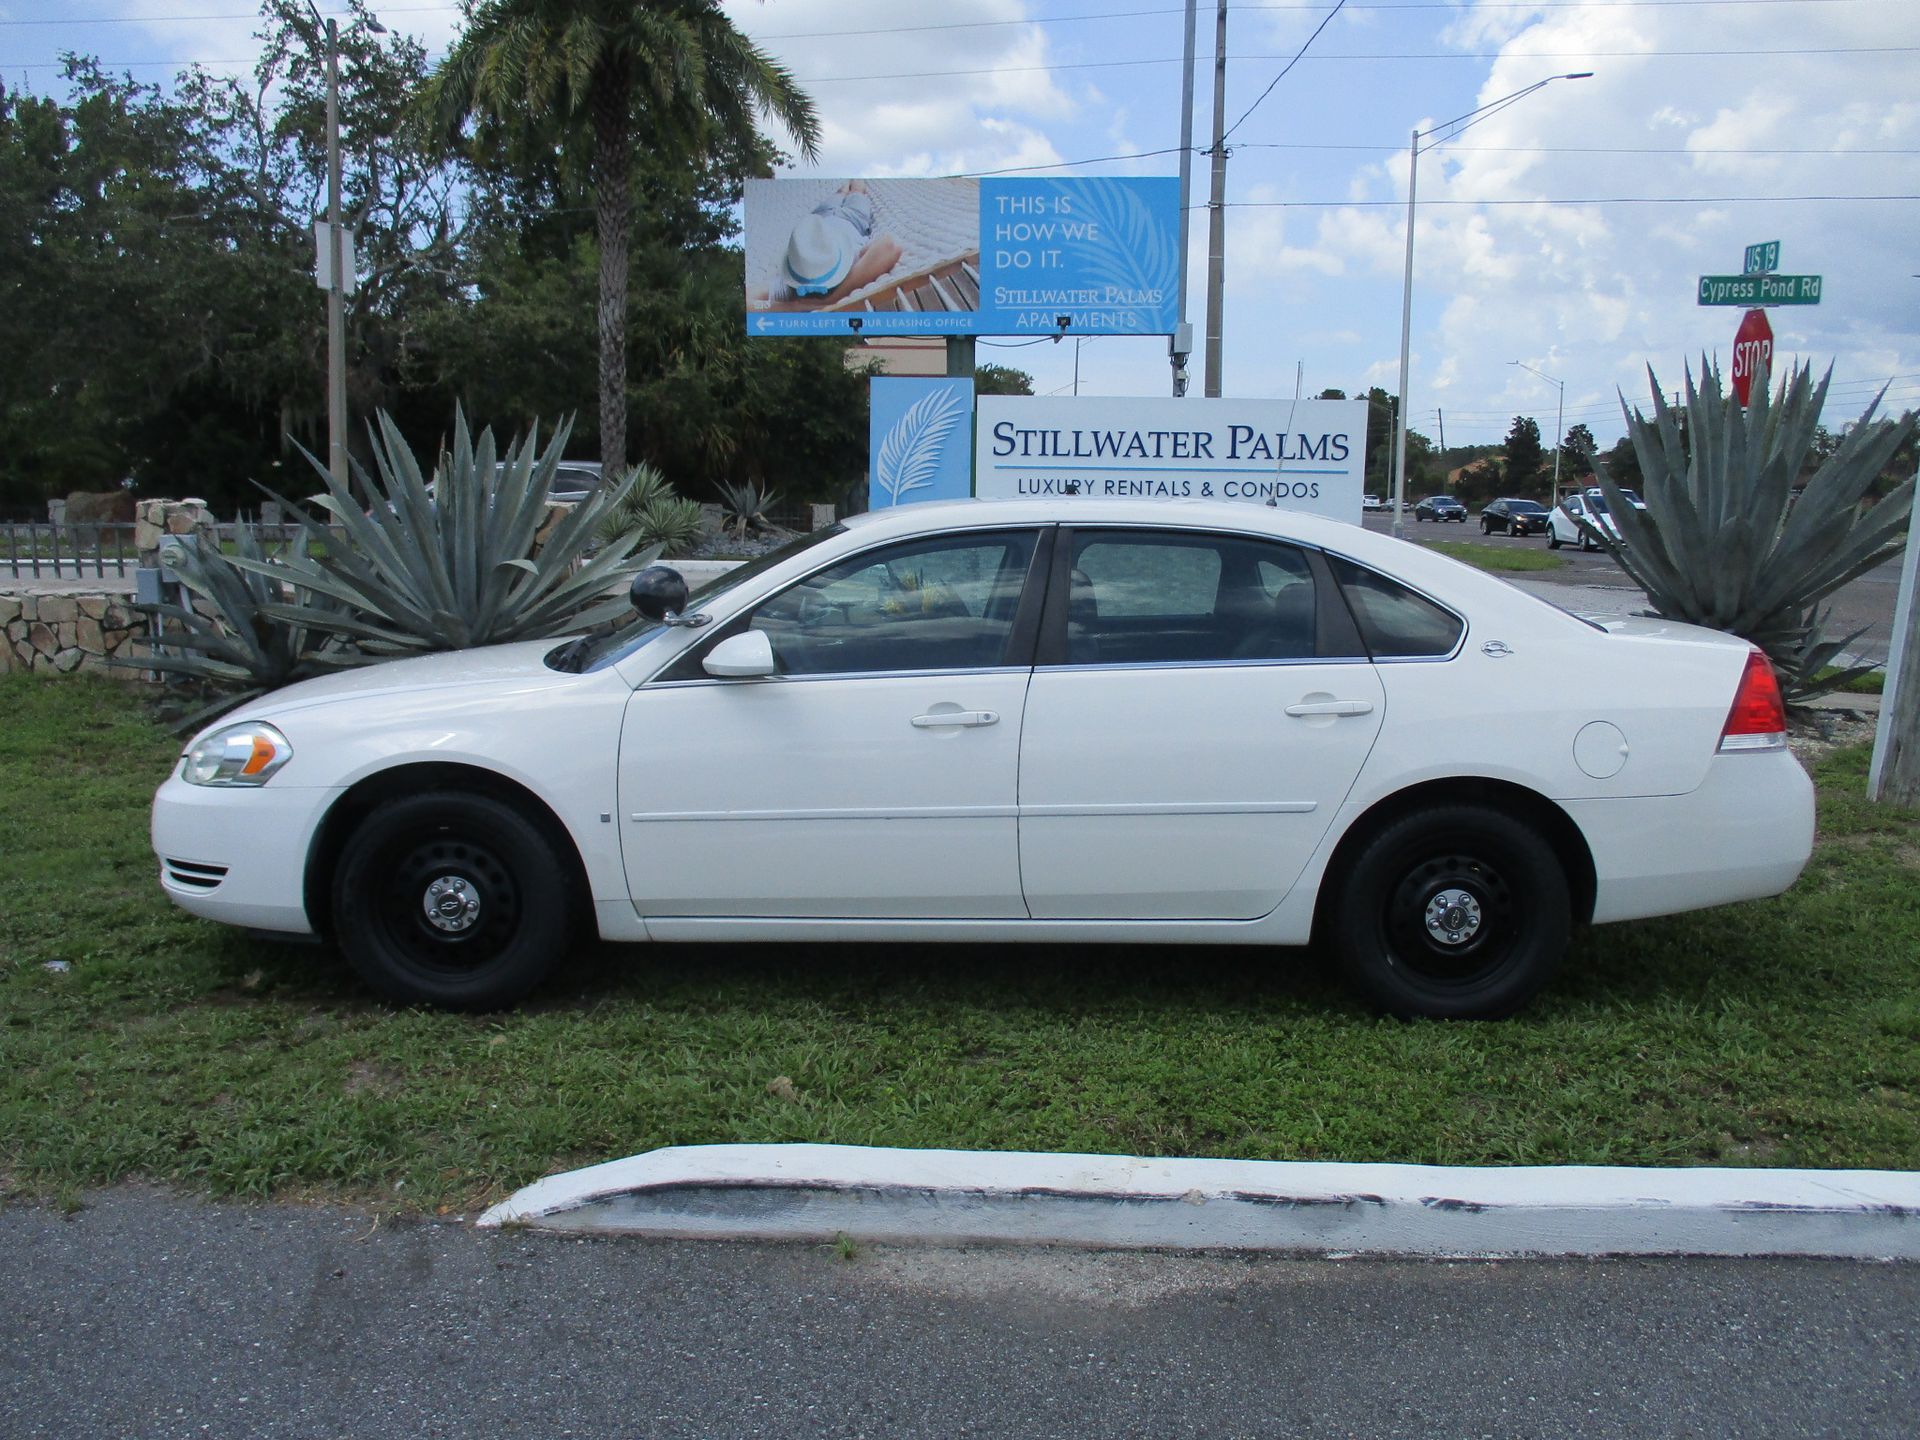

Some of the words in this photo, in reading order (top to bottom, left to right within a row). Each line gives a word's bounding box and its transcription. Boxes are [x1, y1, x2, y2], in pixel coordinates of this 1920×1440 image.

[995, 196, 1045, 215] THIS
[1054, 196, 1072, 214] IS
[995, 223, 1056, 242] HOW
[1061, 223, 1099, 241] WE
[996, 251, 1032, 269] DO
[1041, 250, 1064, 269] IT.
[1746, 246, 1760, 273] US
[1765, 243, 1776, 270] 19
[994, 286, 1098, 305] STILLWATER
[1105, 286, 1163, 304] PALMS
[1700, 278, 1755, 303] Cypress
[1760, 278, 1796, 298] Pond
[1801, 277, 1820, 297] Rd
[779, 319, 808, 328] TURN
[813, 319, 836, 328] LEFT
[886, 318, 931, 328] LEASING
[935, 318, 973, 327] OFFICE
[992, 421, 1215, 459] STILLWATER
[1226, 425, 1350, 461] PALMS
[1018, 478, 1095, 495] LUXURY
[1104, 479, 1191, 497] RENTALS
[1201, 480, 1214, 497] &
[1223, 480, 1320, 498] CONDOS
